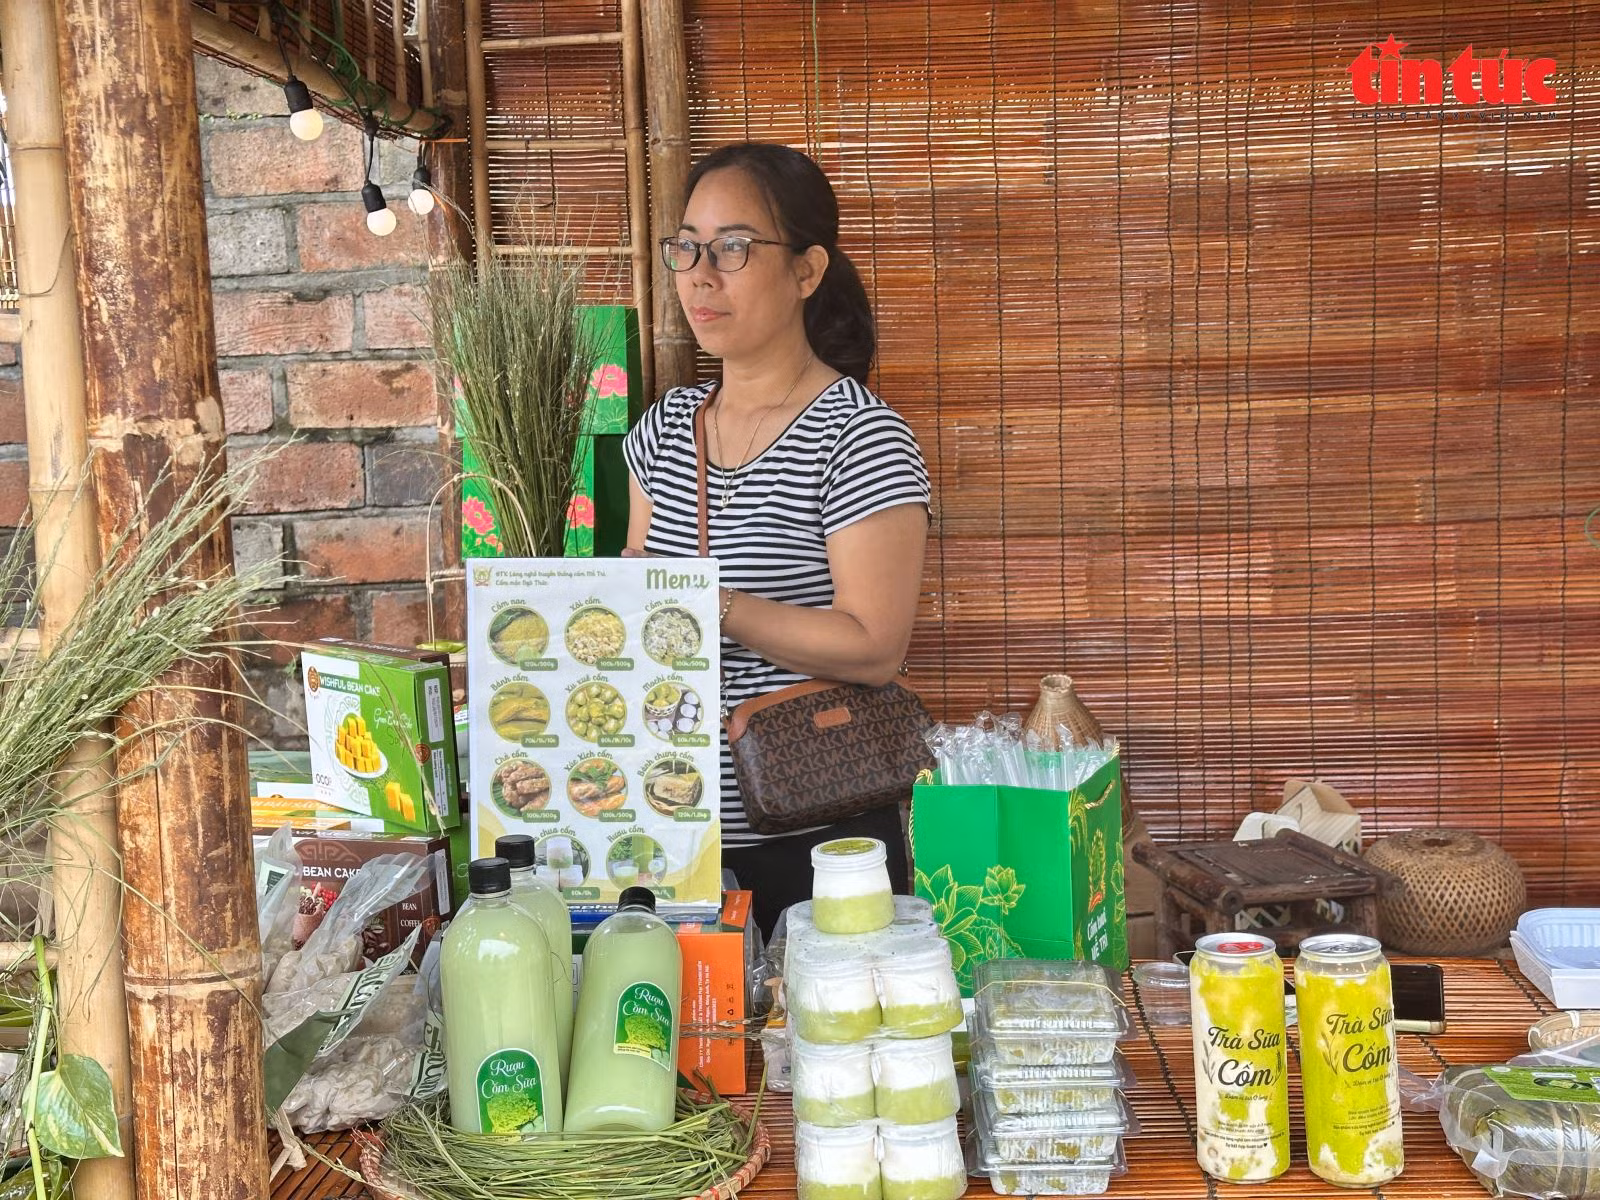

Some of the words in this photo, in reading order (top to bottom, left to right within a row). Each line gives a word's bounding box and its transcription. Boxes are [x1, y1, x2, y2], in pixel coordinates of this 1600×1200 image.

[646, 568, 710, 590] Menu
[512, 672, 529, 683] cốm
[592, 674, 609, 683] cốm
[667, 672, 683, 682] cốm
[320, 676, 347, 689] WISHFUL
[346, 681, 363, 693] BEAN
[364, 686, 381, 697] CAKE
[511, 750, 528, 759] cốm
[597, 750, 613, 760] cốm
[679, 751, 696, 762] cốm
[560, 826, 576, 836] cốm
[628, 825, 645, 834] cốm
[303, 866, 332, 878] BEAN
[402, 903, 417, 911] BEAN
[1326, 1013, 1366, 1036] Trà
[1208, 1026, 1244, 1050] Trà
[1249, 1028, 1281, 1051] Sữa
[1343, 1041, 1392, 1073] Cốm
[1217, 1059, 1274, 1087] Cốm
